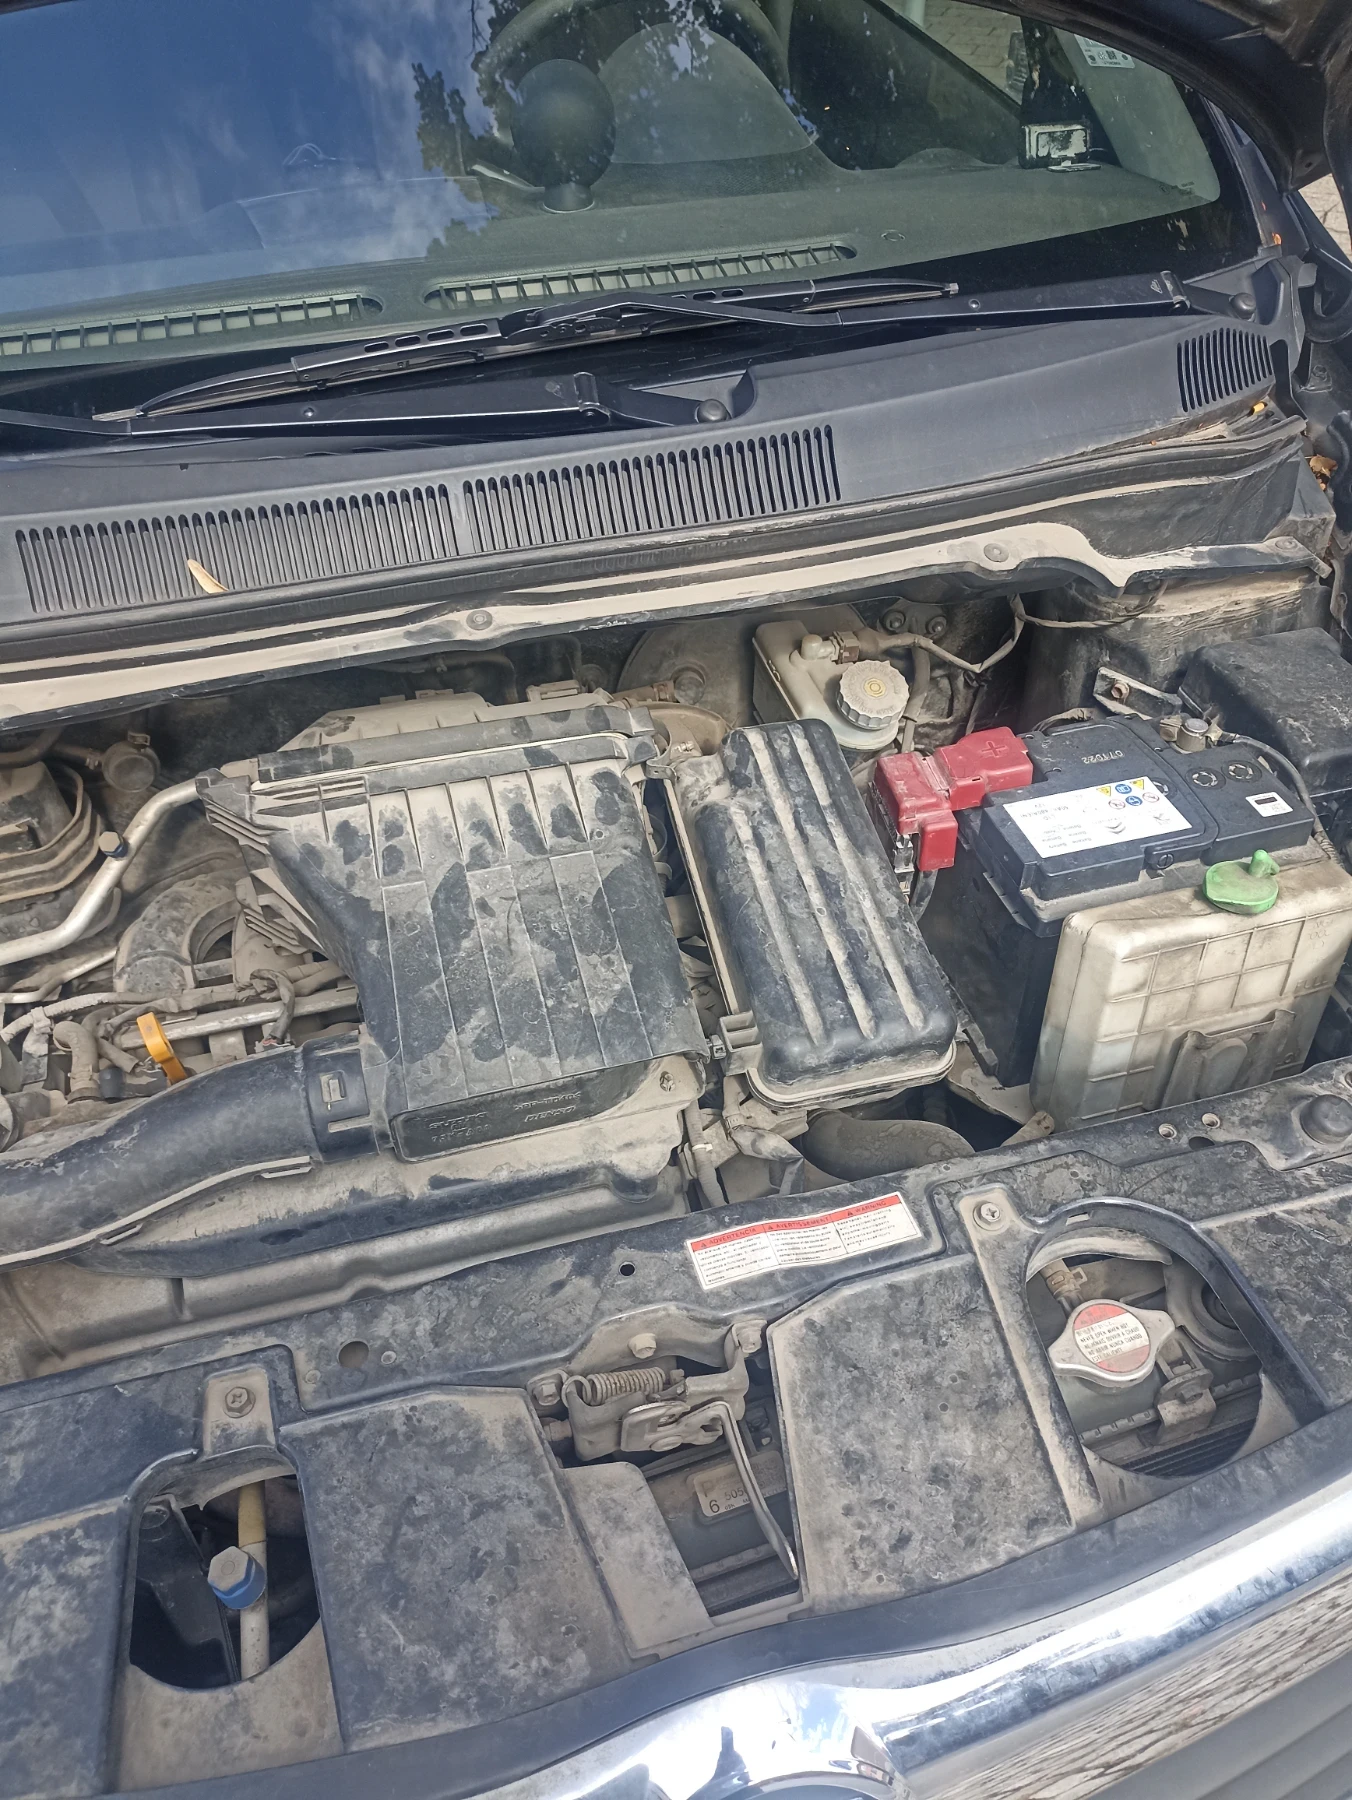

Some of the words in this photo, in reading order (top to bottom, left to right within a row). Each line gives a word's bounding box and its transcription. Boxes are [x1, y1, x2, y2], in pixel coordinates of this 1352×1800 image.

[855, 1200, 887, 1214] WARNING
[776, 1217, 829, 1229] AVERTISSEMENT
[708, 1227, 757, 1245] ADVERTENCIA
[1080, 1334, 1094, 1343] NEVER
[1094, 1330, 1107, 1338] OPEN
[1107, 1325, 1119, 1334] WHEN
[1119, 1322, 1128, 1330] HOT
[725, 1488, 748, 1500] 505
[709, 1499, 720, 1514] 6
